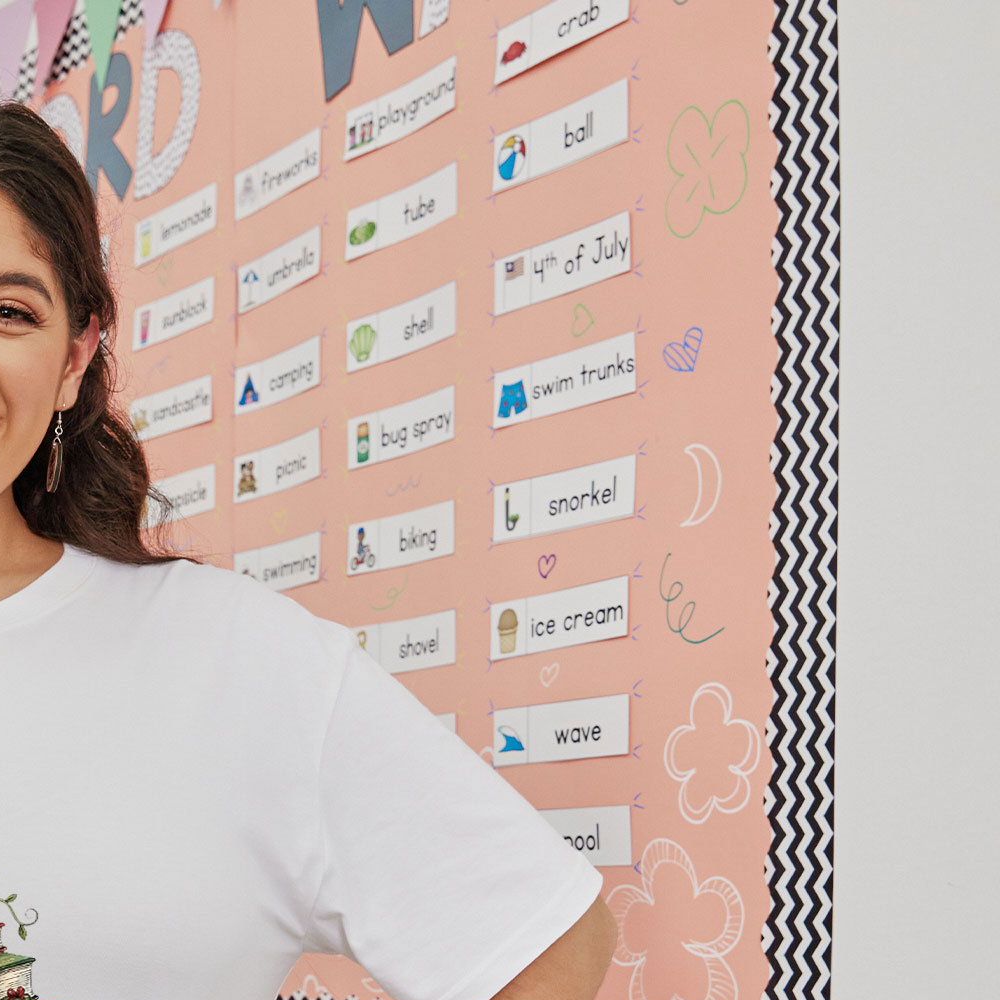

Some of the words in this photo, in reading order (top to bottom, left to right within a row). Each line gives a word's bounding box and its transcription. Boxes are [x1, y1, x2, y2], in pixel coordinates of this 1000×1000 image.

[557, 0, 600, 38] crab
[377, 65, 457, 134] playground
[564, 110, 594, 149] ball
[261, 148, 318, 194] fireworks
[161, 200, 214, 241] lemonade
[403, 194, 436, 225] tube
[267, 247, 315, 287] umbrella
[533, 252, 558, 283] 4th
[564, 243, 586, 275] of
[591, 230, 629, 264] July
[162, 292, 208, 330] sunblock
[403, 306, 435, 341] shell
[269, 361, 314, 392] camping
[531, 374, 574, 400] swim
[580, 351, 635, 387] trunks
[152, 386, 210, 422] sandcastle
[380, 424, 408, 449] bug
[412, 410, 452, 442] spray
[275, 456, 307, 485] picnic
[548, 475, 617, 517] snorkel
[399, 528, 437, 553] biking
[263, 554, 317, 583] swimming
[530, 617, 556, 639] ice
[563, 603, 624, 632] cream
[398, 627, 440, 660] shovel
[554, 724, 602, 745] wave
